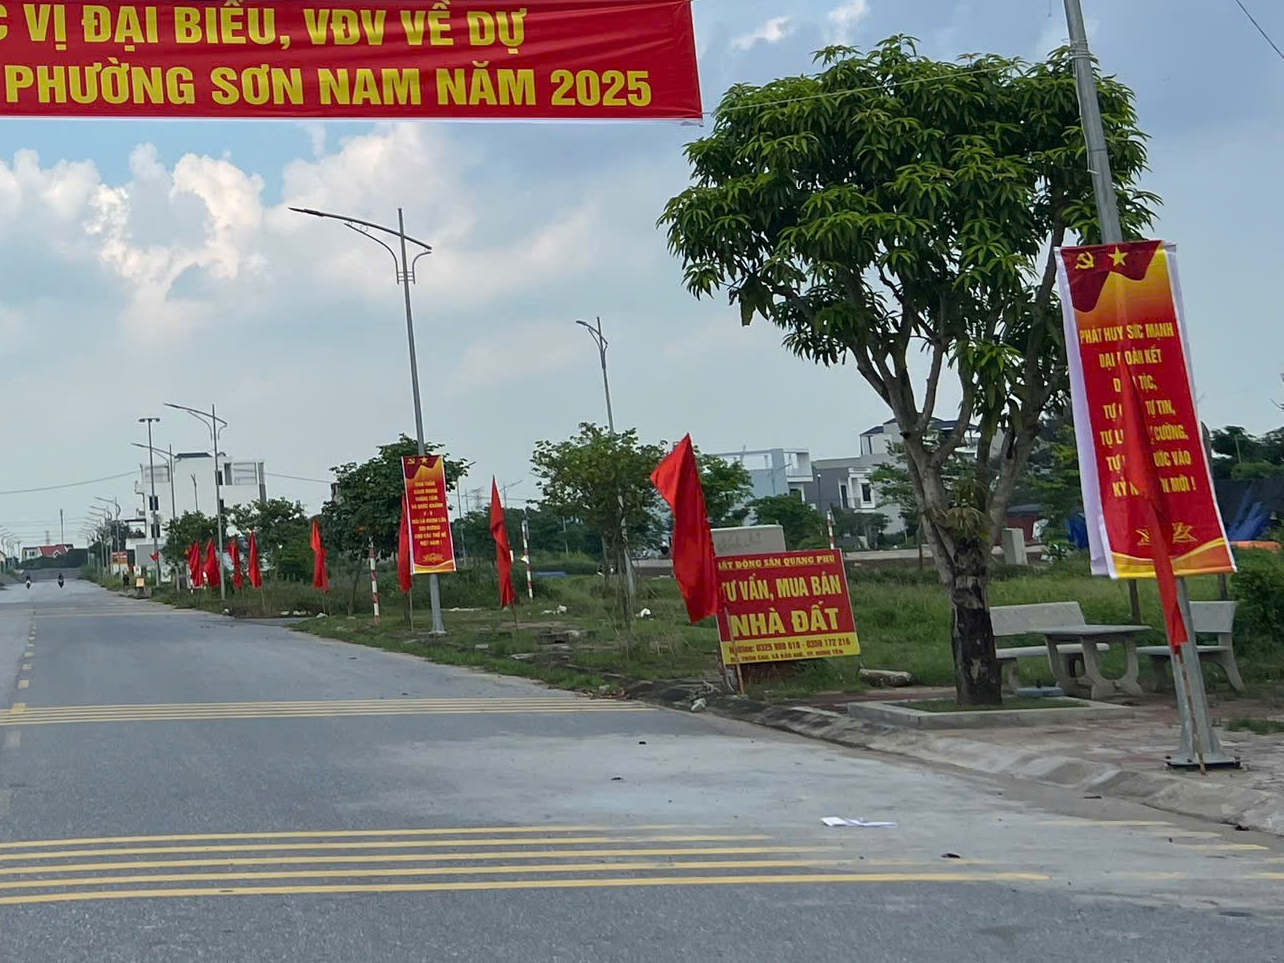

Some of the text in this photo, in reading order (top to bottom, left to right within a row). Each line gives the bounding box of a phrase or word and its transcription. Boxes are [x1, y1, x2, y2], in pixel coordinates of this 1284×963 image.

[24, 4, 67, 51] VỊ
[82, 5, 159, 52] ĐẠI
[304, 9, 386, 46] VĐV
[401, 3, 454, 46] VỀ
[468, 8, 527, 55] DỰ
[5, 57, 196, 104] PHƯỜNG
[211, 63, 304, 105] SƠN
[318, 69, 422, 105] NAM
[437, 61, 537, 106] NĂM
[551, 69, 652, 107] 2025
[1080, 325, 1102, 344] PHÁT
[1104, 326, 1123, 341] HUY
[1145, 322, 1174, 340] MẠNH
[1144, 344, 1162, 363] KẾT
[1103, 403, 1117, 422] TỰ
[1145, 400, 1156, 418] TỰ
[1156, 400, 1176, 415] TIN,
[1100, 429, 1113, 448] TỰ
[1106, 448, 1191, 473] TỰ ƯỚC VÀO
[1112, 477, 1127, 497] KỶ
[1170, 474, 1190, 492] MỚI
[739, 572, 774, 601] VẤN,
[776, 576, 809, 598] MUA
[811, 571, 842, 596] BÁN
[730, 601, 839, 637] NHÀ ĐẤT
